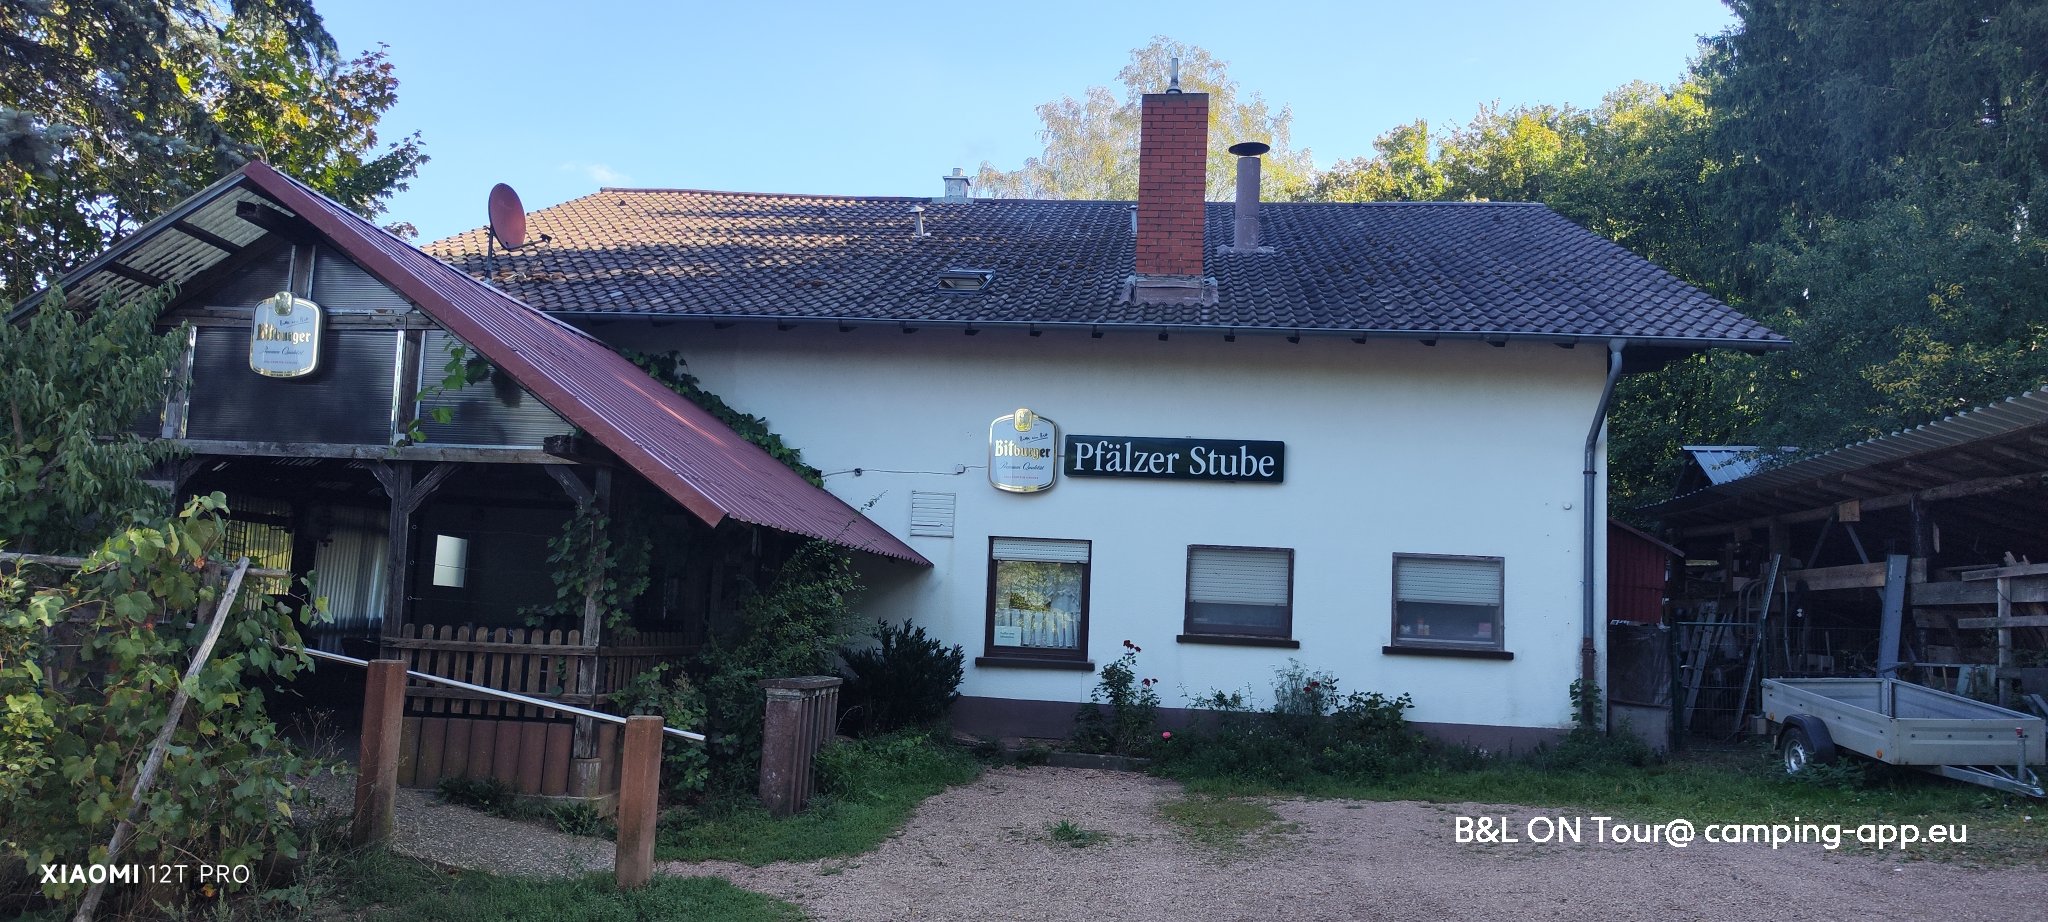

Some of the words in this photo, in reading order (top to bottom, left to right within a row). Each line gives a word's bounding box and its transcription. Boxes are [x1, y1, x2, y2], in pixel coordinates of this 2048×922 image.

[994, 439, 1051, 460] Bitburger
[1074, 440, 1179, 475] Pfälzer
[1189, 445, 1275, 477] Stube
